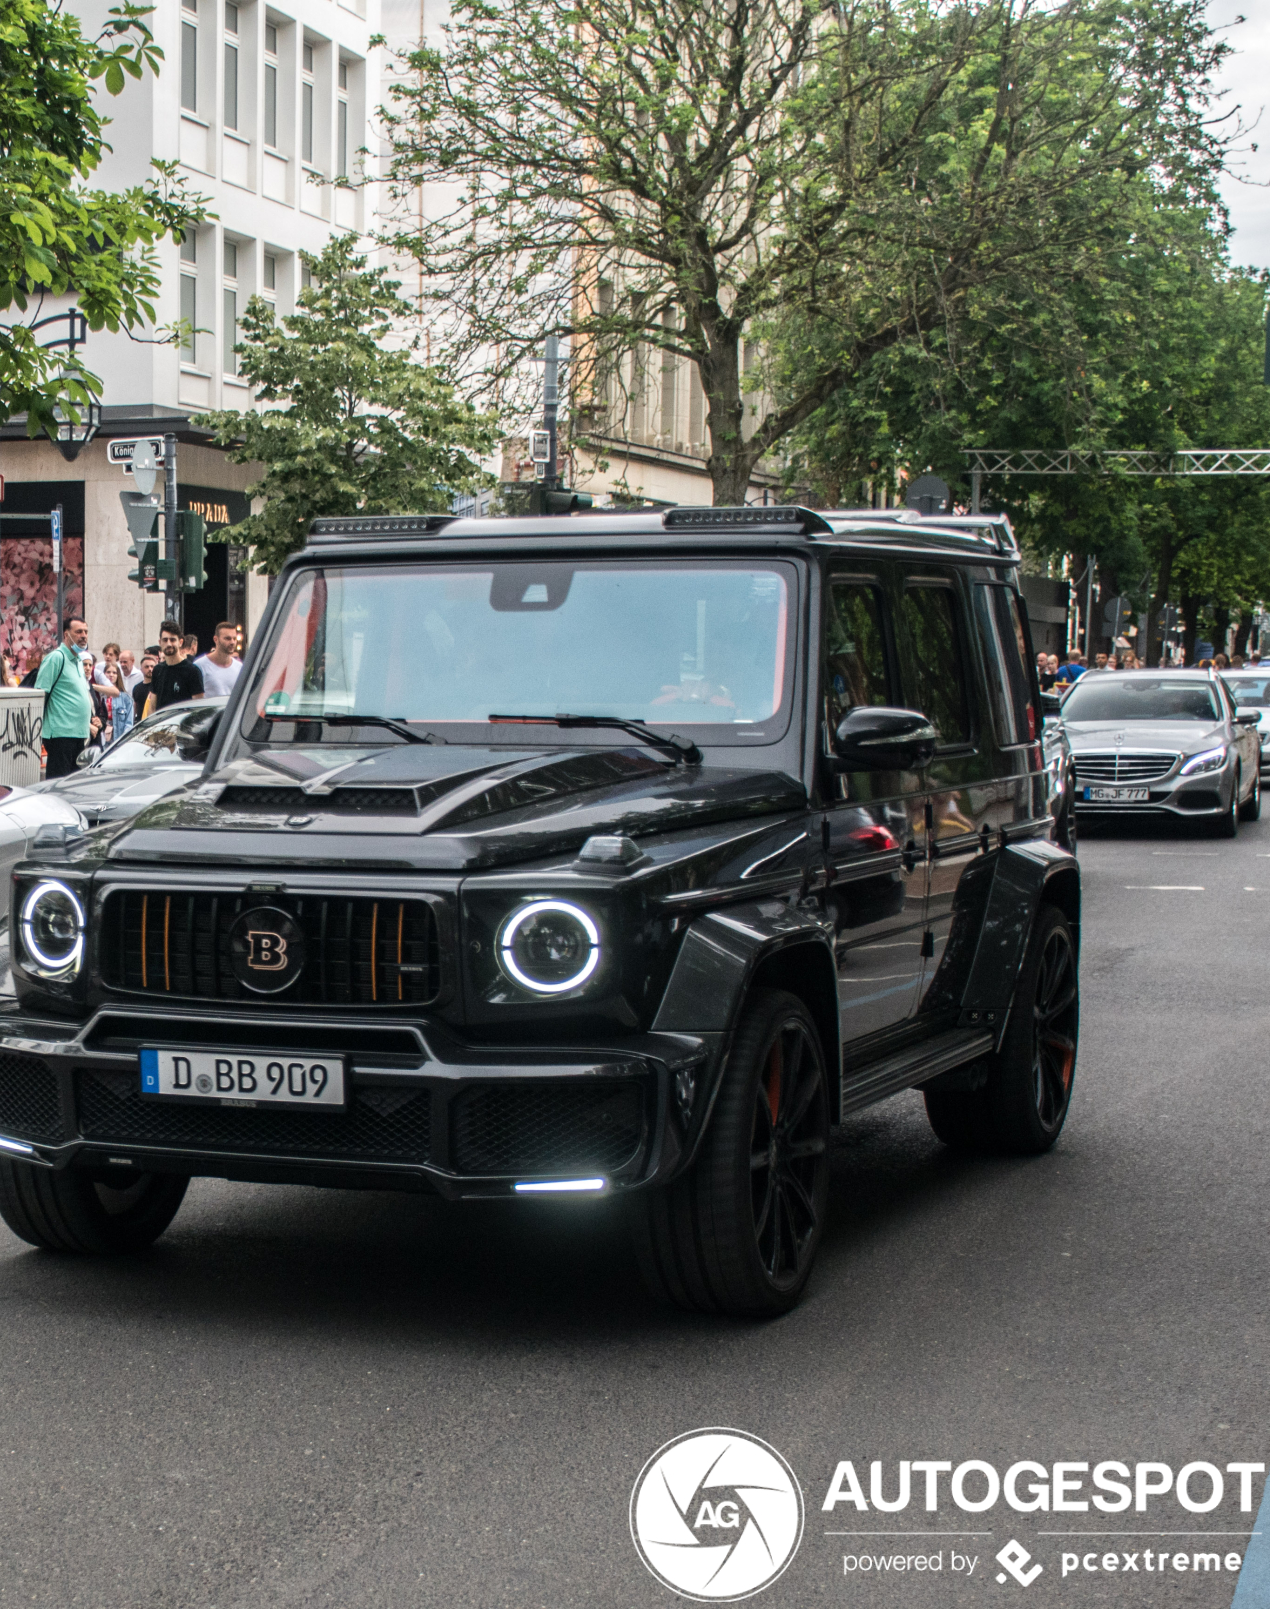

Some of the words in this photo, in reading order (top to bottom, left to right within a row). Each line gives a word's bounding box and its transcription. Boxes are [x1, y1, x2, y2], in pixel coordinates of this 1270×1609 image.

[1127, 788, 1147, 799] 777
[172, 1056, 192, 1090] D
[215, 1059, 258, 1094] BB
[266, 1062, 328, 1098] 909
